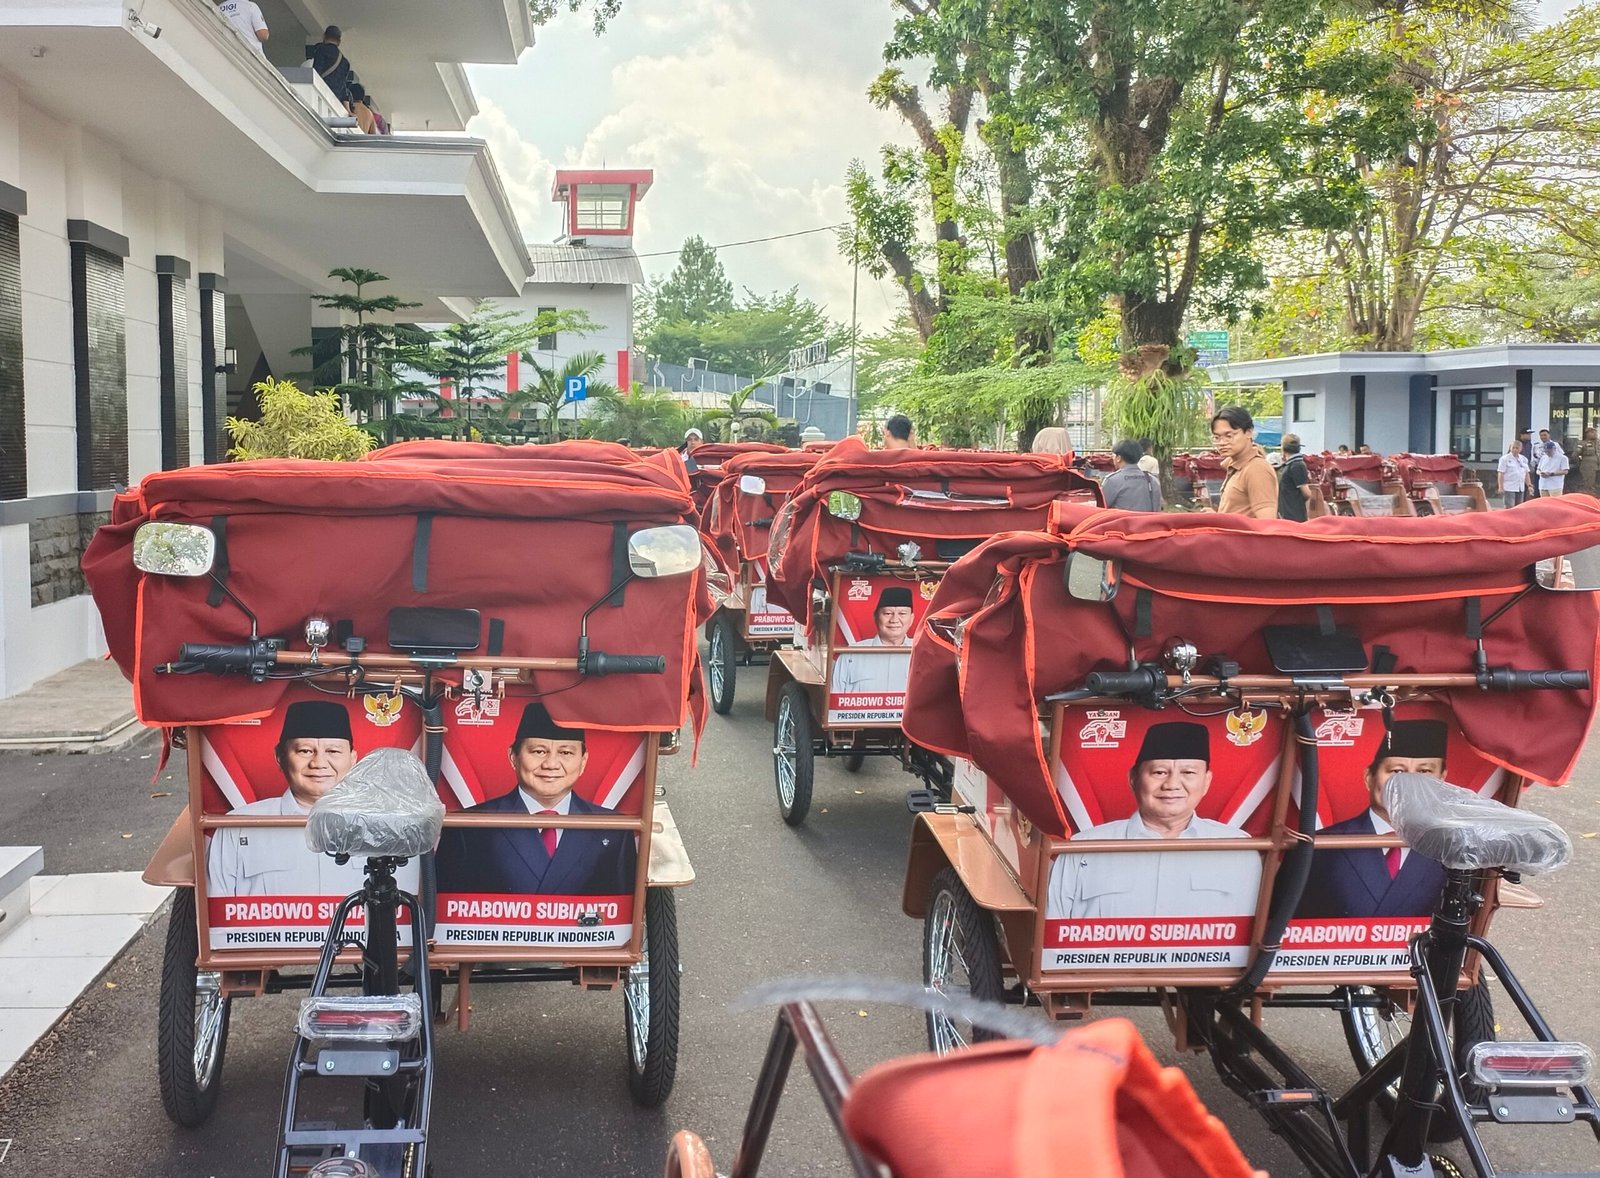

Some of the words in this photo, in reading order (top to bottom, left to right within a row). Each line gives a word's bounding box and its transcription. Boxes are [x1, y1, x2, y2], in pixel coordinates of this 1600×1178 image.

[569, 379, 582, 398] P
[753, 615, 785, 623] PRABOWO
[838, 696, 883, 707] PRABOWO
[884, 696, 906, 707] SUBI
[837, 712, 866, 720] PRESIDEN
[867, 712, 894, 720] REPUBLIK
[225, 903, 314, 921] PRABOWO
[447, 900, 532, 919] PRABOWO
[226, 932, 281, 944] PRESIDEN
[285, 931, 326, 943] REPUBL
[446, 929, 499, 942] PRESIDEN
[502, 930, 555, 943] REPUBLIK
[558, 931, 615, 943] INDONESIA
[1058, 924, 1146, 943] PRABOWO
[1149, 923, 1237, 941] SUBIANTO
[1279, 925, 1367, 944] PRABOWO
[1056, 953, 1110, 964] PRESIDEN
[1114, 952, 1168, 964] REPUBLIK
[1171, 951, 1231, 963] INDONESIA
[1275, 955, 1330, 967] PRESIDEN
[1333, 955, 1388, 966] REPUBLIK
